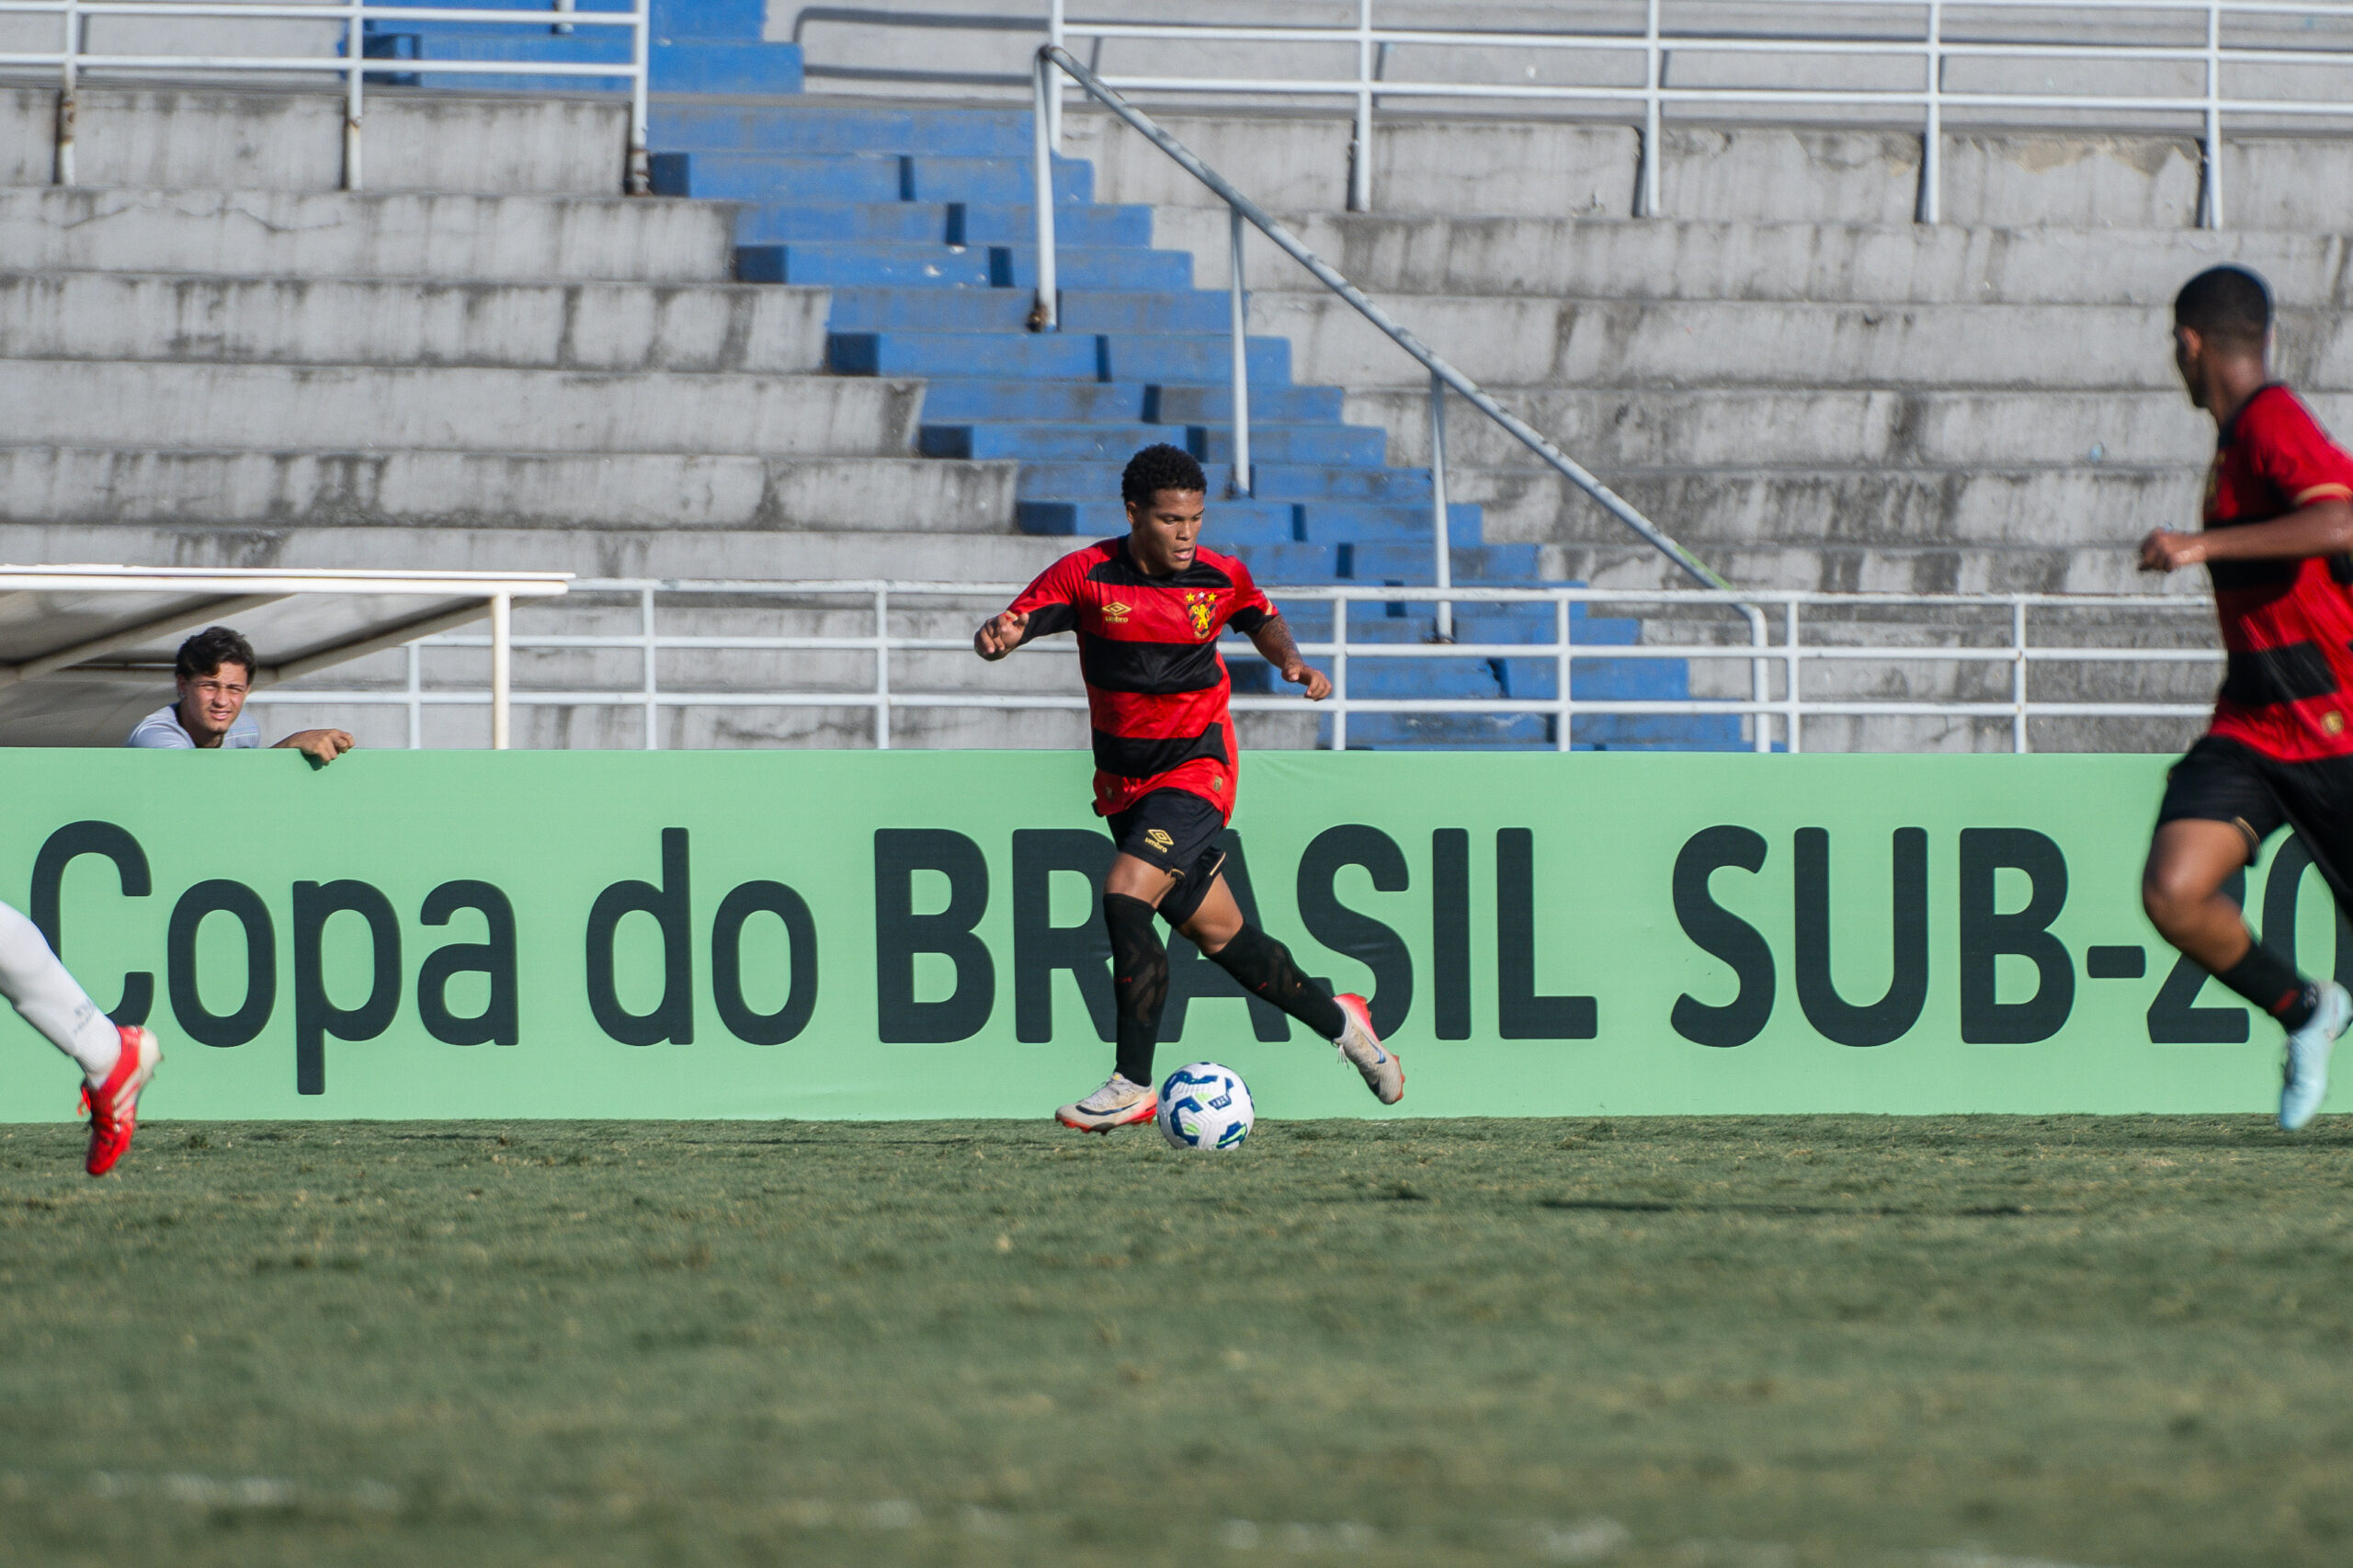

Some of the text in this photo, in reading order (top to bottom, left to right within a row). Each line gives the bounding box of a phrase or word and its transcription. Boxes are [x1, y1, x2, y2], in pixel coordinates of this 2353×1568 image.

[1144, 836, 1167, 853] umbro
[30, 820, 519, 1095] Copa
[585, 827, 818, 1046] do
[874, 824, 1598, 1044] BRASIL
